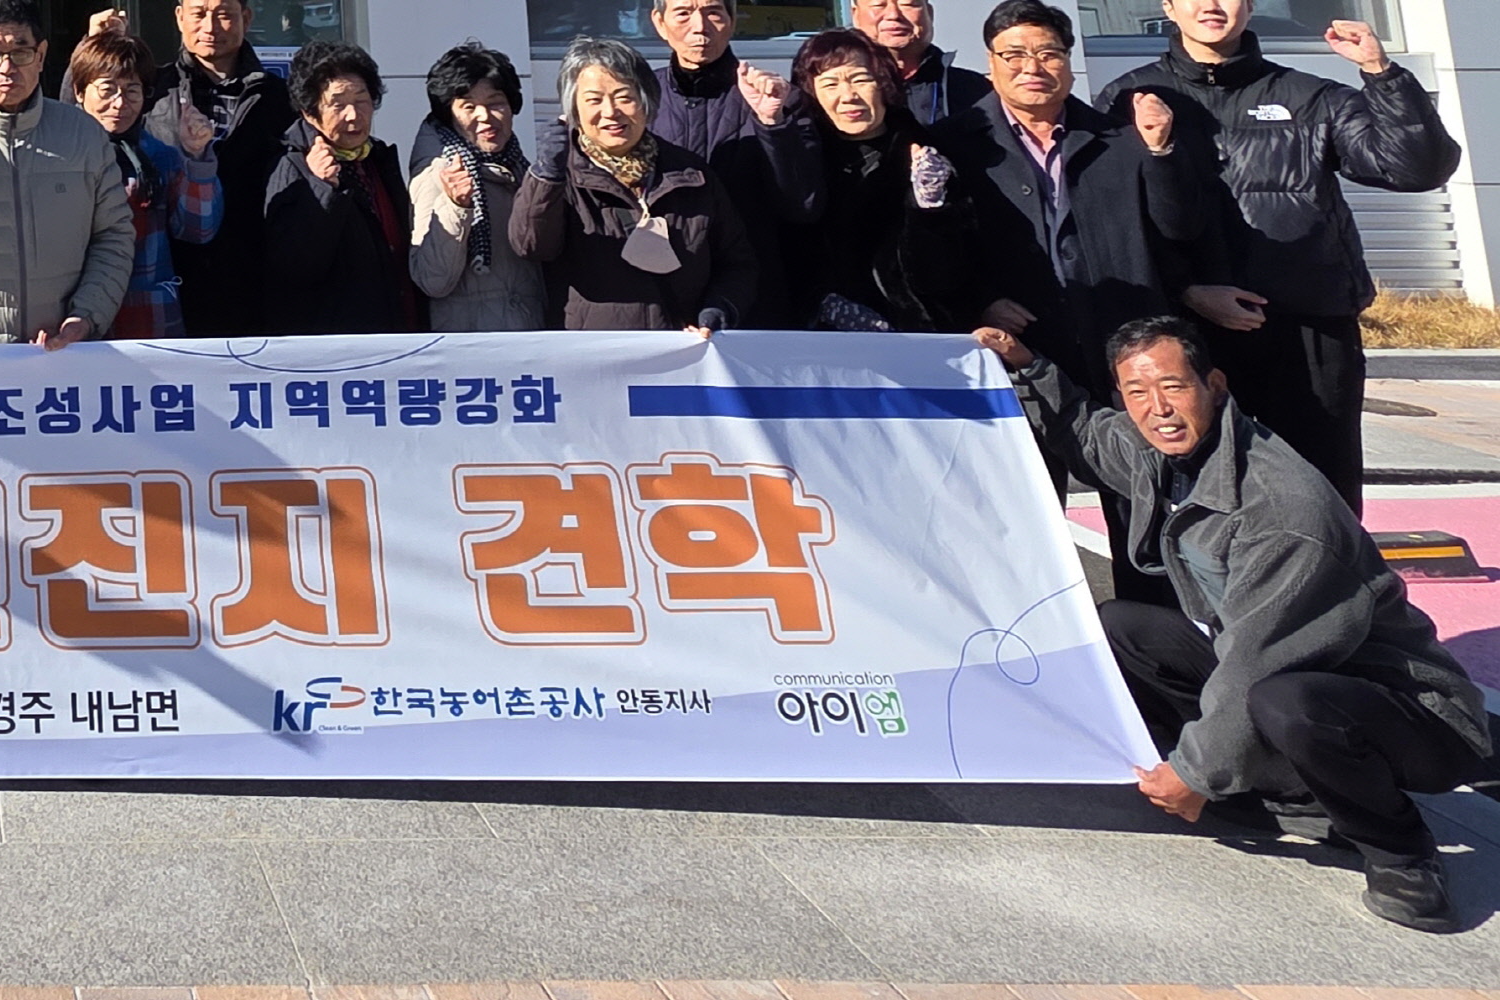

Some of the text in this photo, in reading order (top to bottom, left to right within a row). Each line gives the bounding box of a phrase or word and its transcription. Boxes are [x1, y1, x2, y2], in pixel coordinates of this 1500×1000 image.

[229, 375, 562, 430] 지역역량강화
[453, 451, 836, 646] 견학
[773, 671, 894, 686] communication
[70, 689, 181, 734] 내남면
[370, 686, 713, 718] 한국농어촌공사 안동지사
